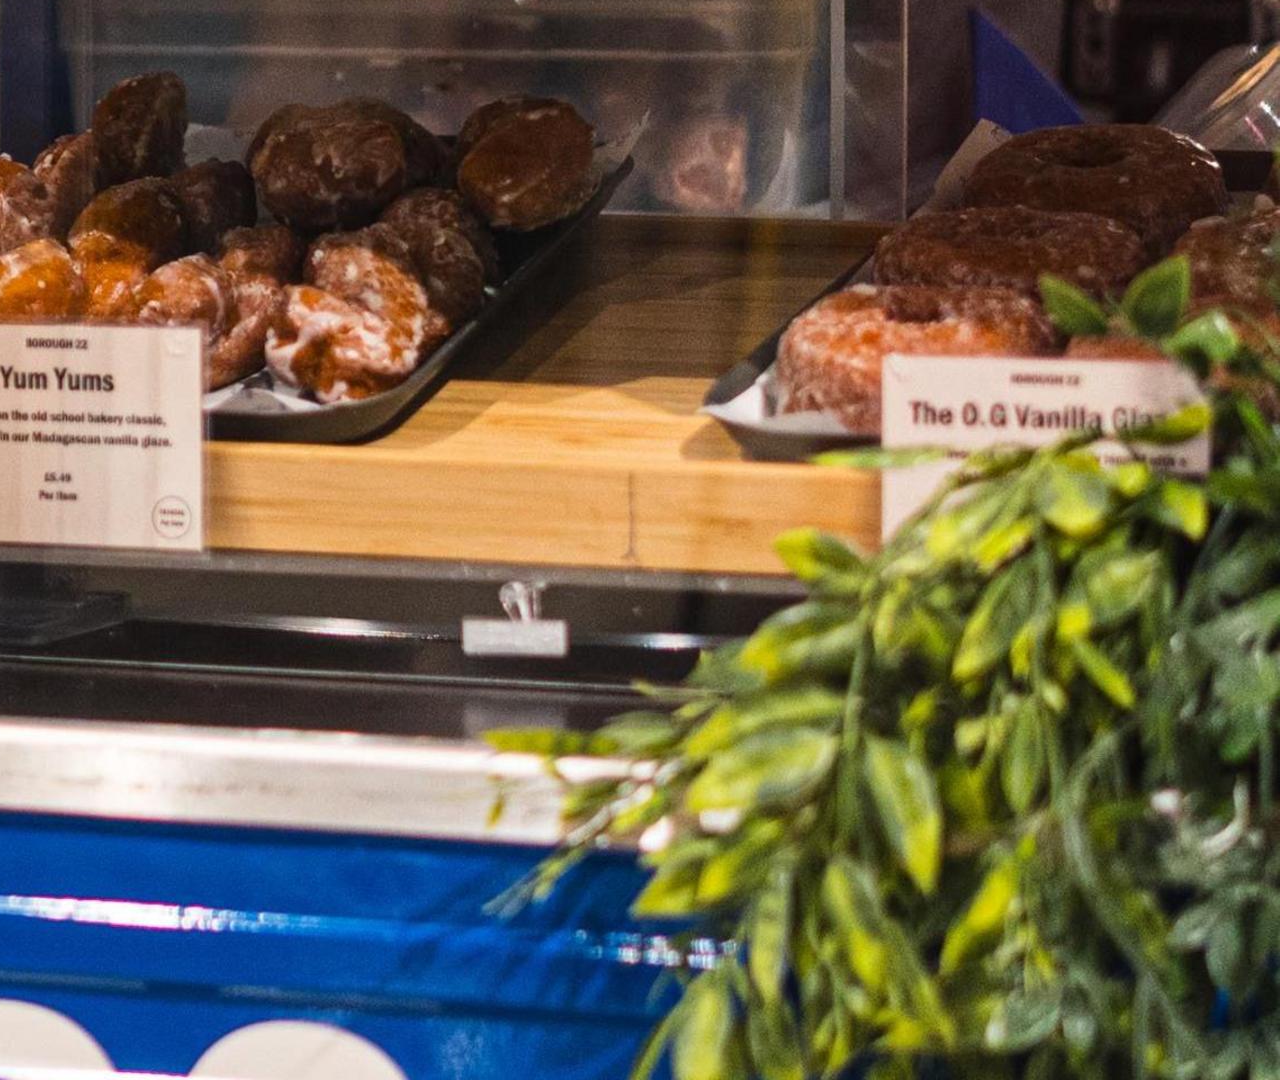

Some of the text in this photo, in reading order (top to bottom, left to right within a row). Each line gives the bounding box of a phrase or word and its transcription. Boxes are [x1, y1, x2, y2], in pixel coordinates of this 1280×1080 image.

[0, 365, 114, 392] Yum Yums
[911, 400, 953, 425] The
[1015, 405, 1104, 432] Vanilla
